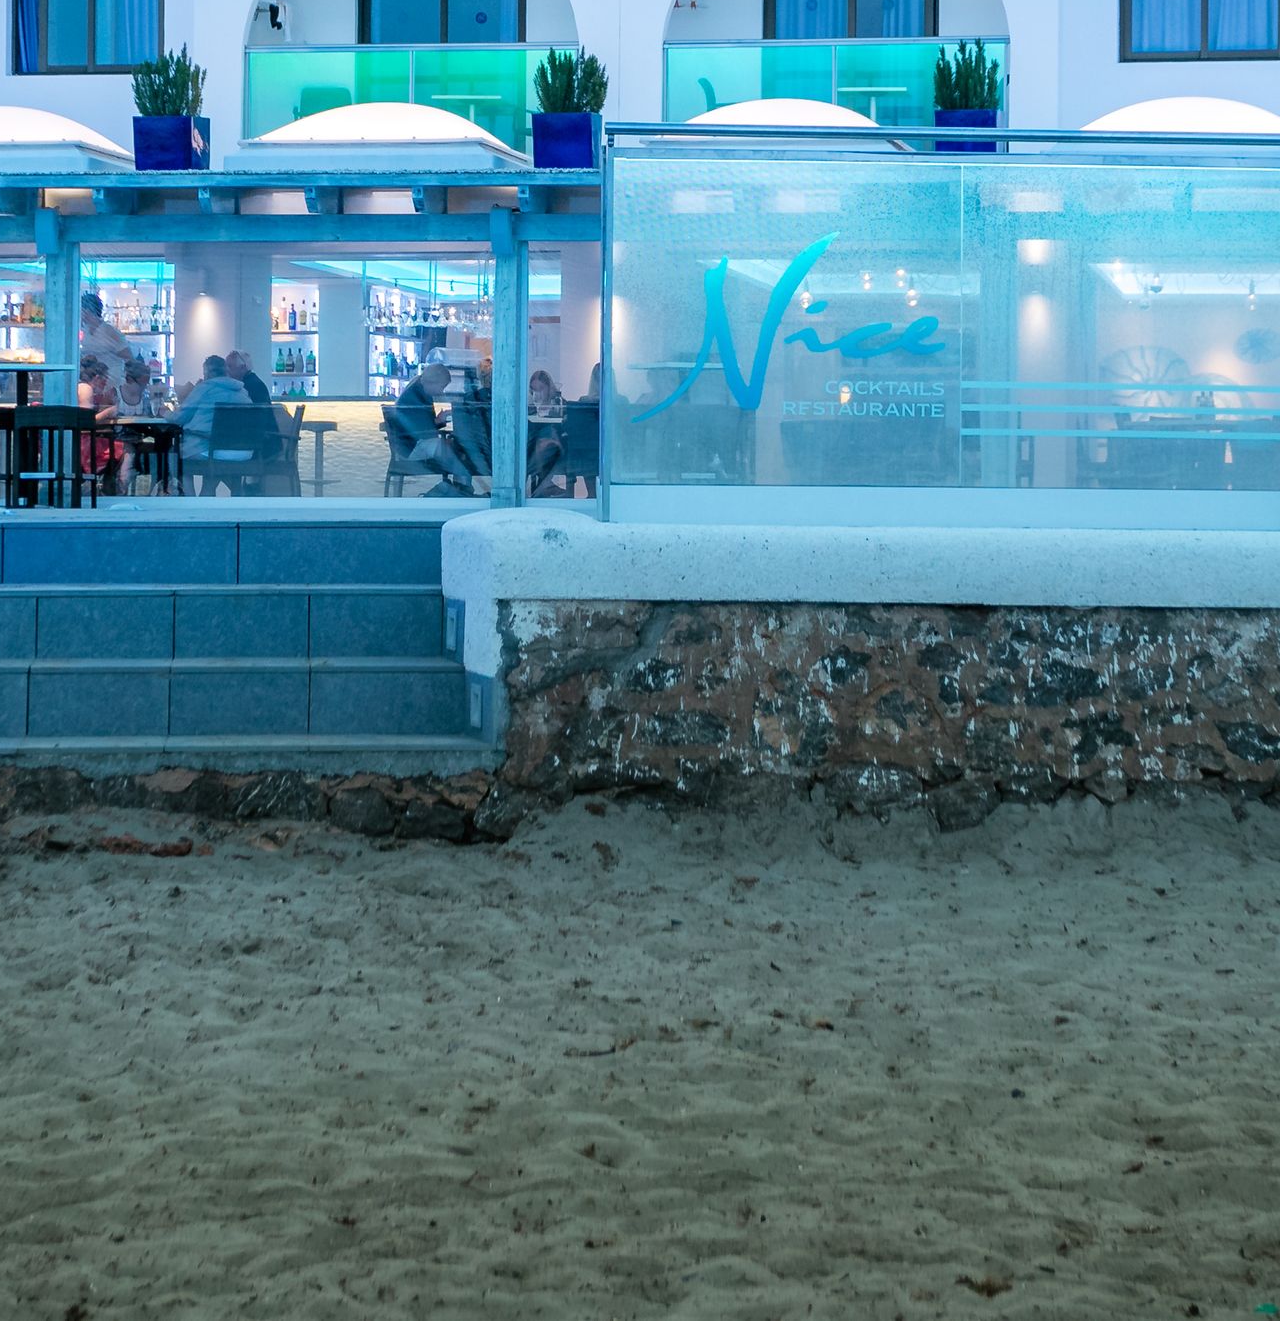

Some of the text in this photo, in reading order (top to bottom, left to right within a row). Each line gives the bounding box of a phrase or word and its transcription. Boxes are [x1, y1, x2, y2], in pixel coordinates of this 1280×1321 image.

[631, 231, 946, 425] Nice
[825, 380, 945, 396] COCKTAILS
[783, 401, 945, 417] RESTAURANTE
